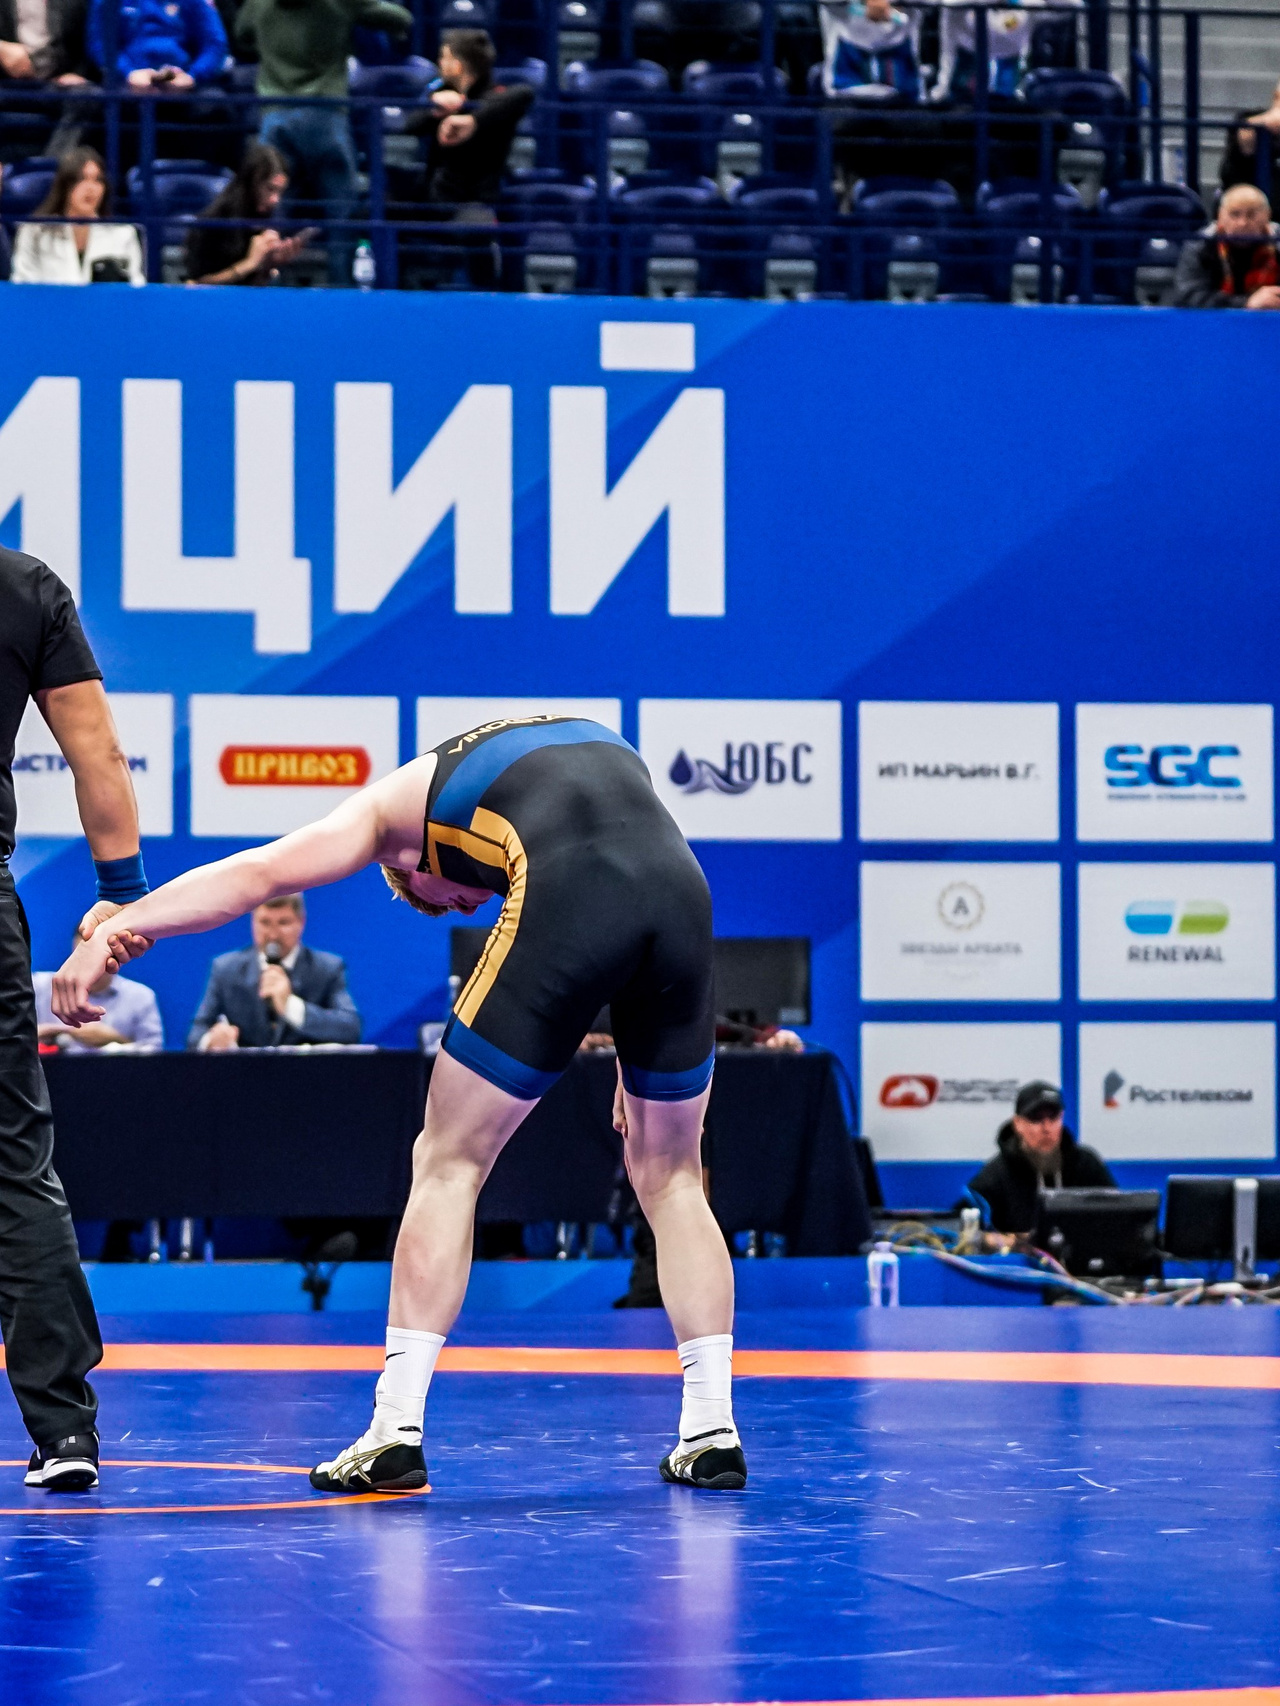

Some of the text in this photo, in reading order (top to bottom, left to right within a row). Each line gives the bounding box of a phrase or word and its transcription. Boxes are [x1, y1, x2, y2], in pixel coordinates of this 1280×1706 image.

[232, 752, 358, 781] ПРИВОЗ
[724, 742, 814, 785] ЮБС
[1104, 744, 1243, 788] SGC
[1127, 945, 1225, 962] RENEWAL
